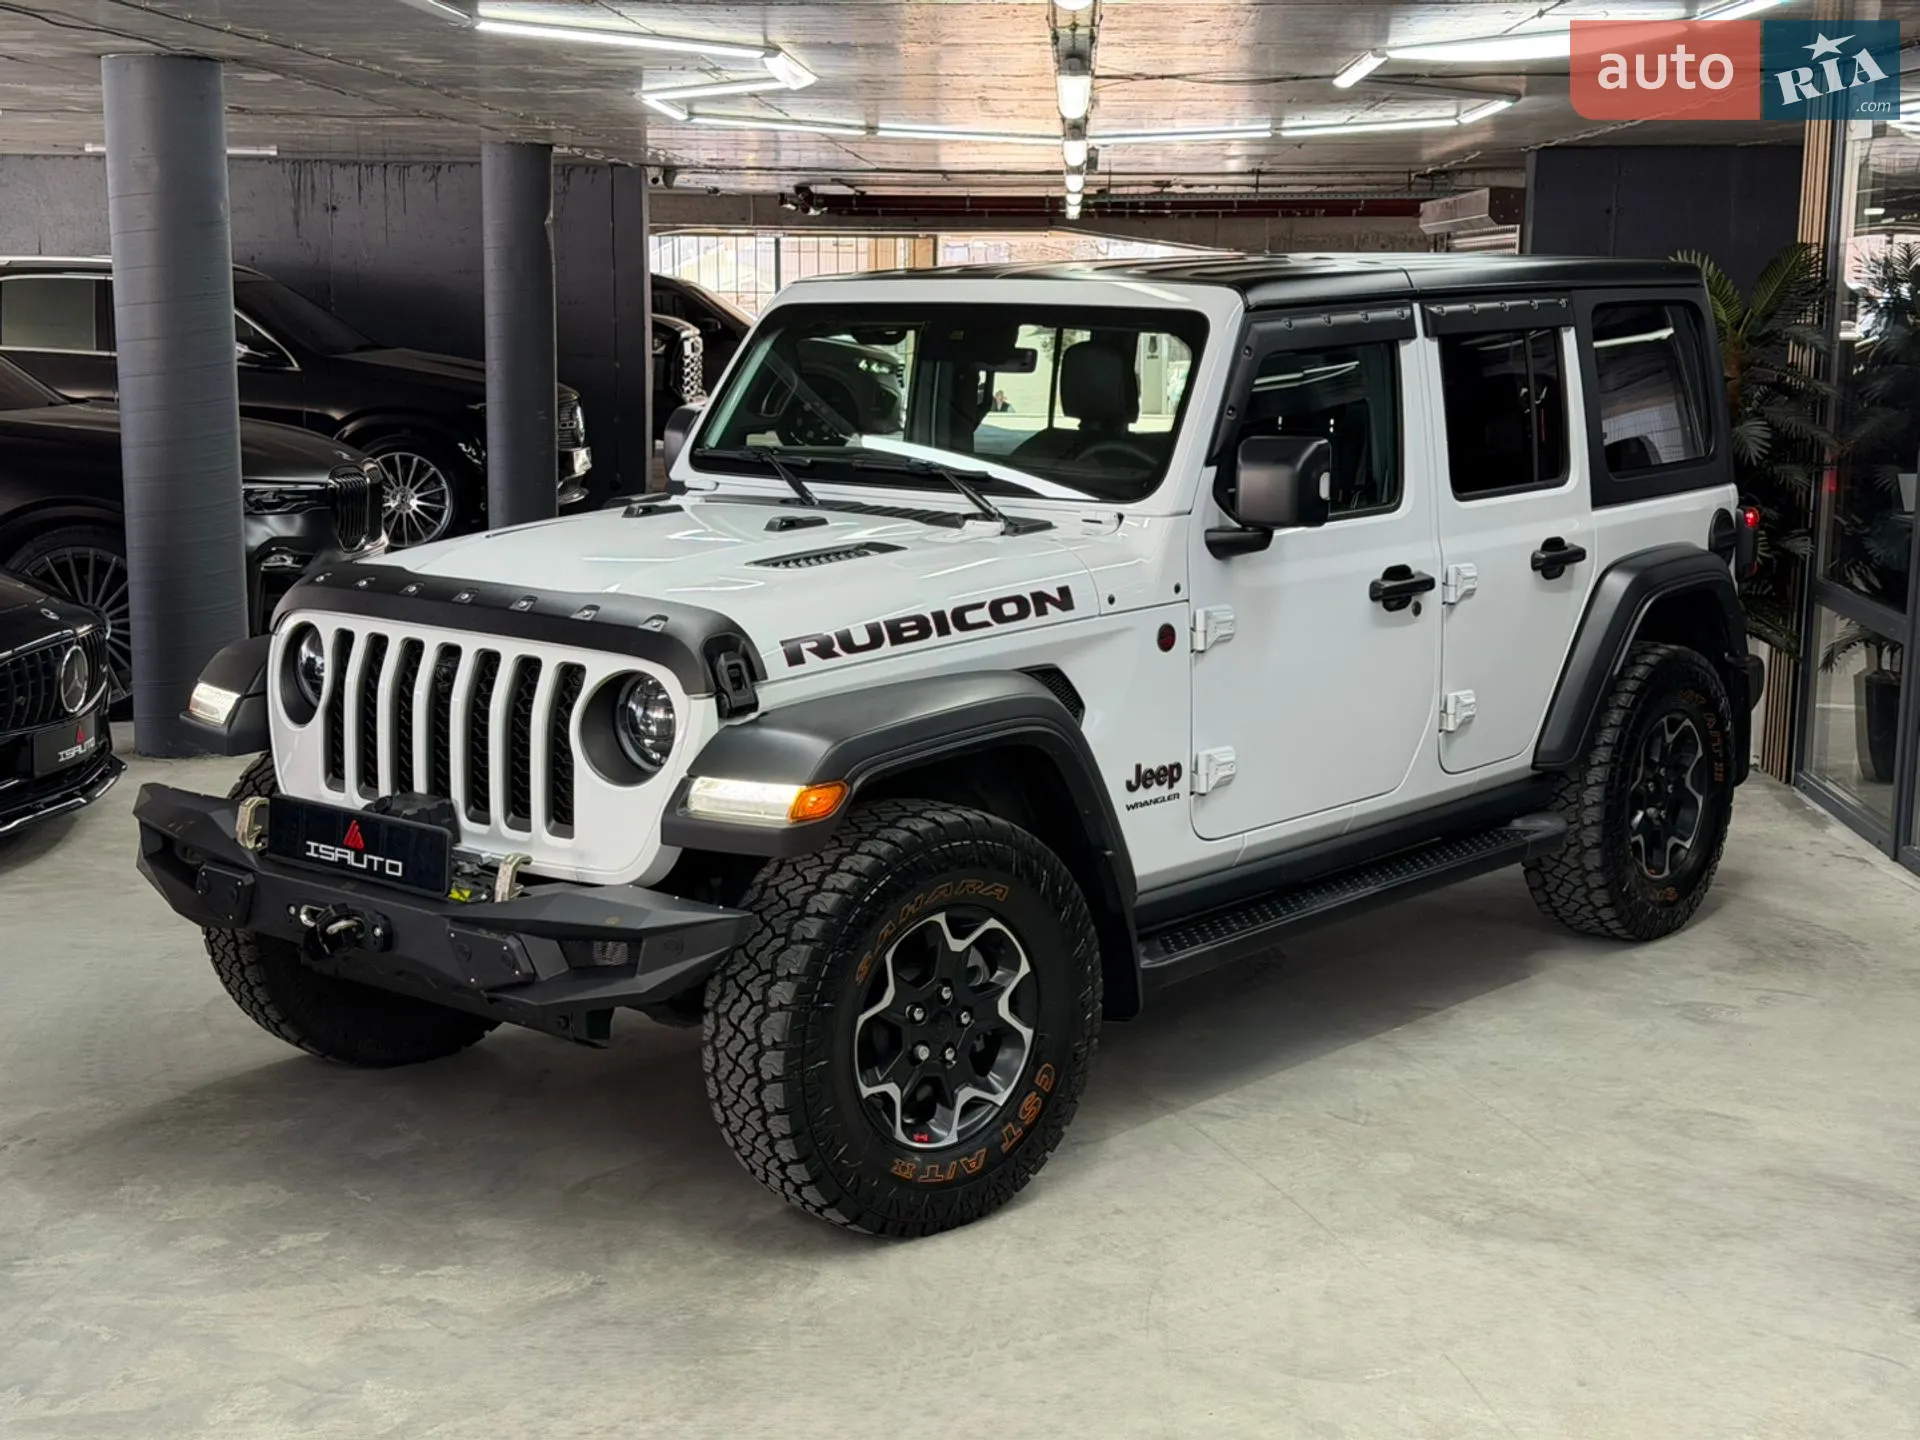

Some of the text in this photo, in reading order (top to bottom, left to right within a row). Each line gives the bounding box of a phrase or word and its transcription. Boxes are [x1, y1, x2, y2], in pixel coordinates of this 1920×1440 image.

[779, 585, 1075, 667] RUBICON
[1125, 761, 1183, 793] Jeep
[1125, 792, 1180, 812] WRANGLER
[305, 840, 403, 877] ISAUTO
[855, 879, 1010, 986] SAHARA
[1001, 1062, 1056, 1155] GST
